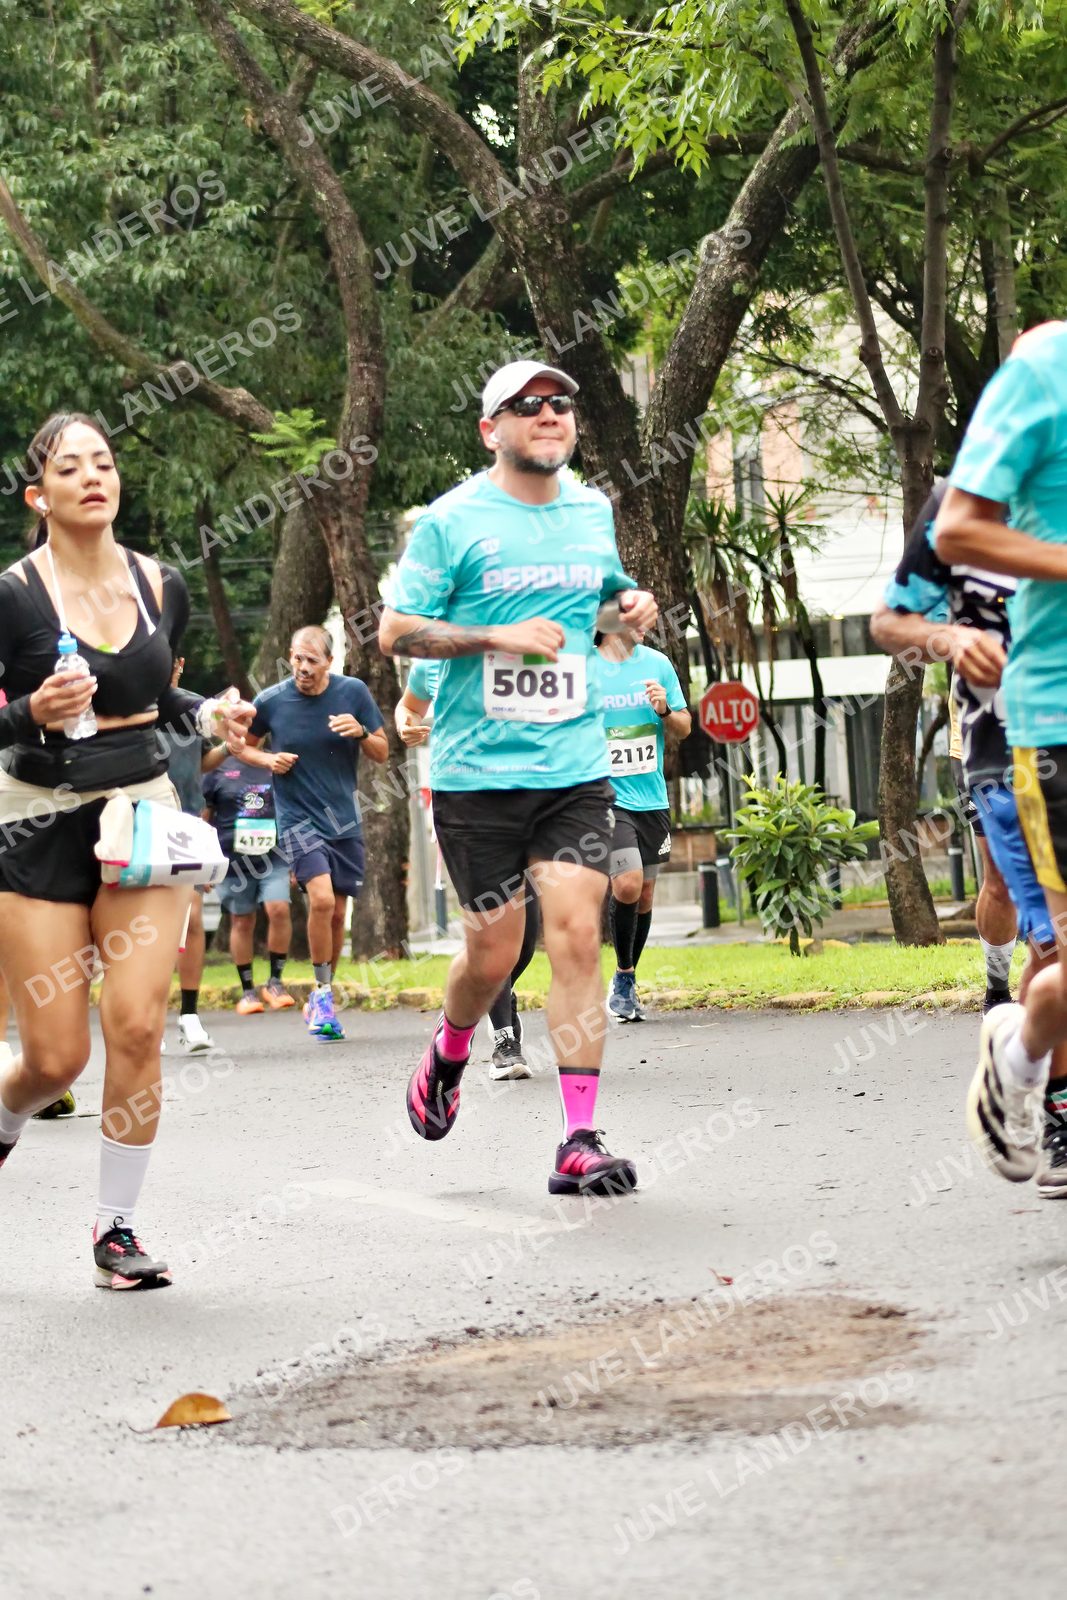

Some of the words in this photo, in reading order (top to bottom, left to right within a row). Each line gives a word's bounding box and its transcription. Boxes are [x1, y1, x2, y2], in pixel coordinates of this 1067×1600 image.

[492, 669, 574, 700] 5081
[705, 698, 755, 725] ALTO
[611, 744, 655, 765] 2112
[239, 836, 273, 847] 4172
